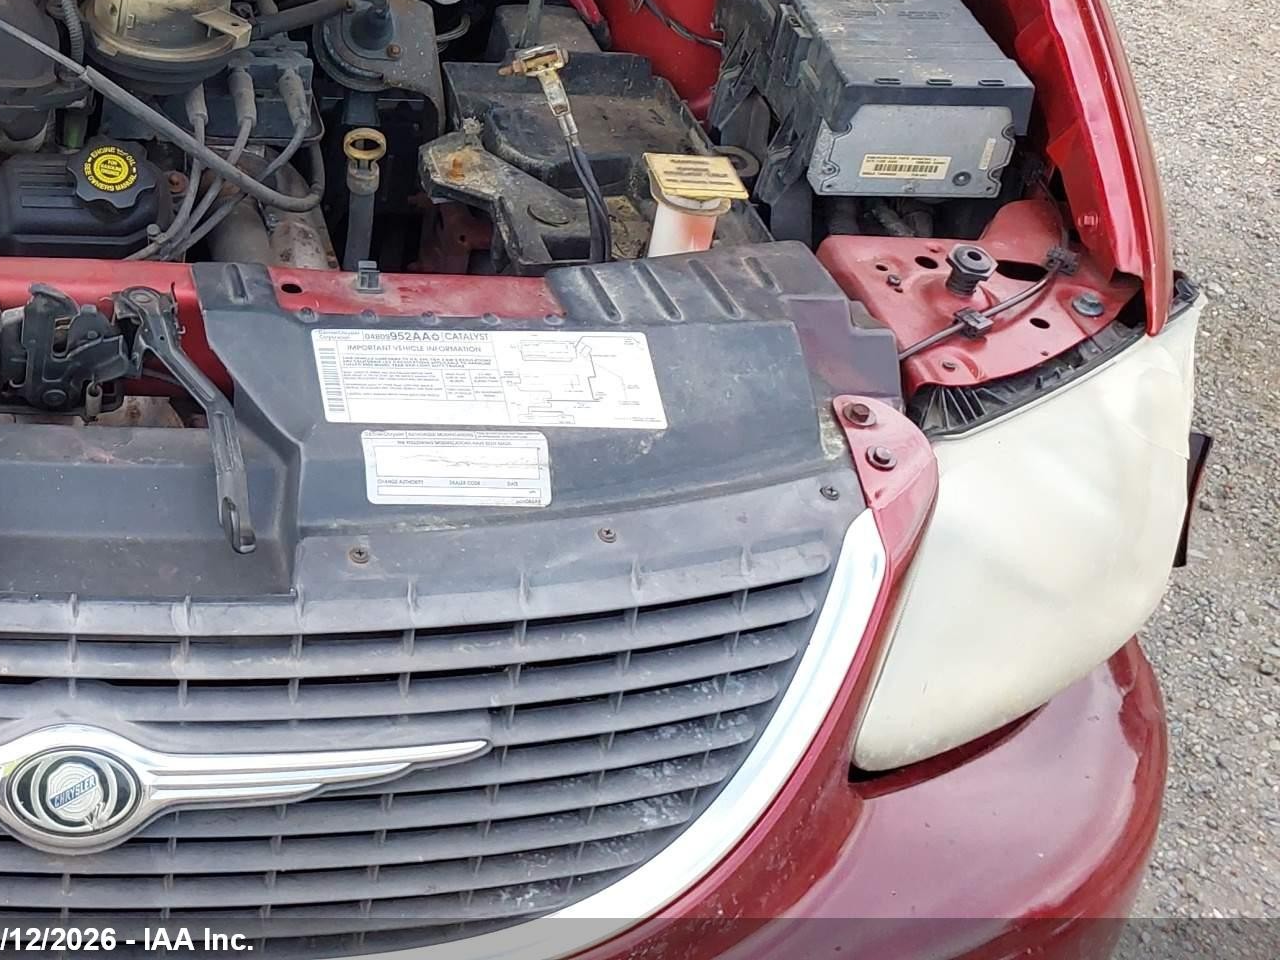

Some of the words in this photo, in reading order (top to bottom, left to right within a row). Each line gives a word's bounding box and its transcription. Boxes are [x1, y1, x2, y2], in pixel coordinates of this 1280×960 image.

[90, 146, 116, 158] ENGINE
[126, 155, 137, 167] OIL
[83, 162, 92, 177] SEE
[444, 332, 489, 342] CATALYST
[347, 344, 392, 352] IMPORTANT
[393, 345, 424, 353] VEHICLE
[426, 345, 482, 353] INFORMATION
[55, 776, 96, 808] CHRYSLER
